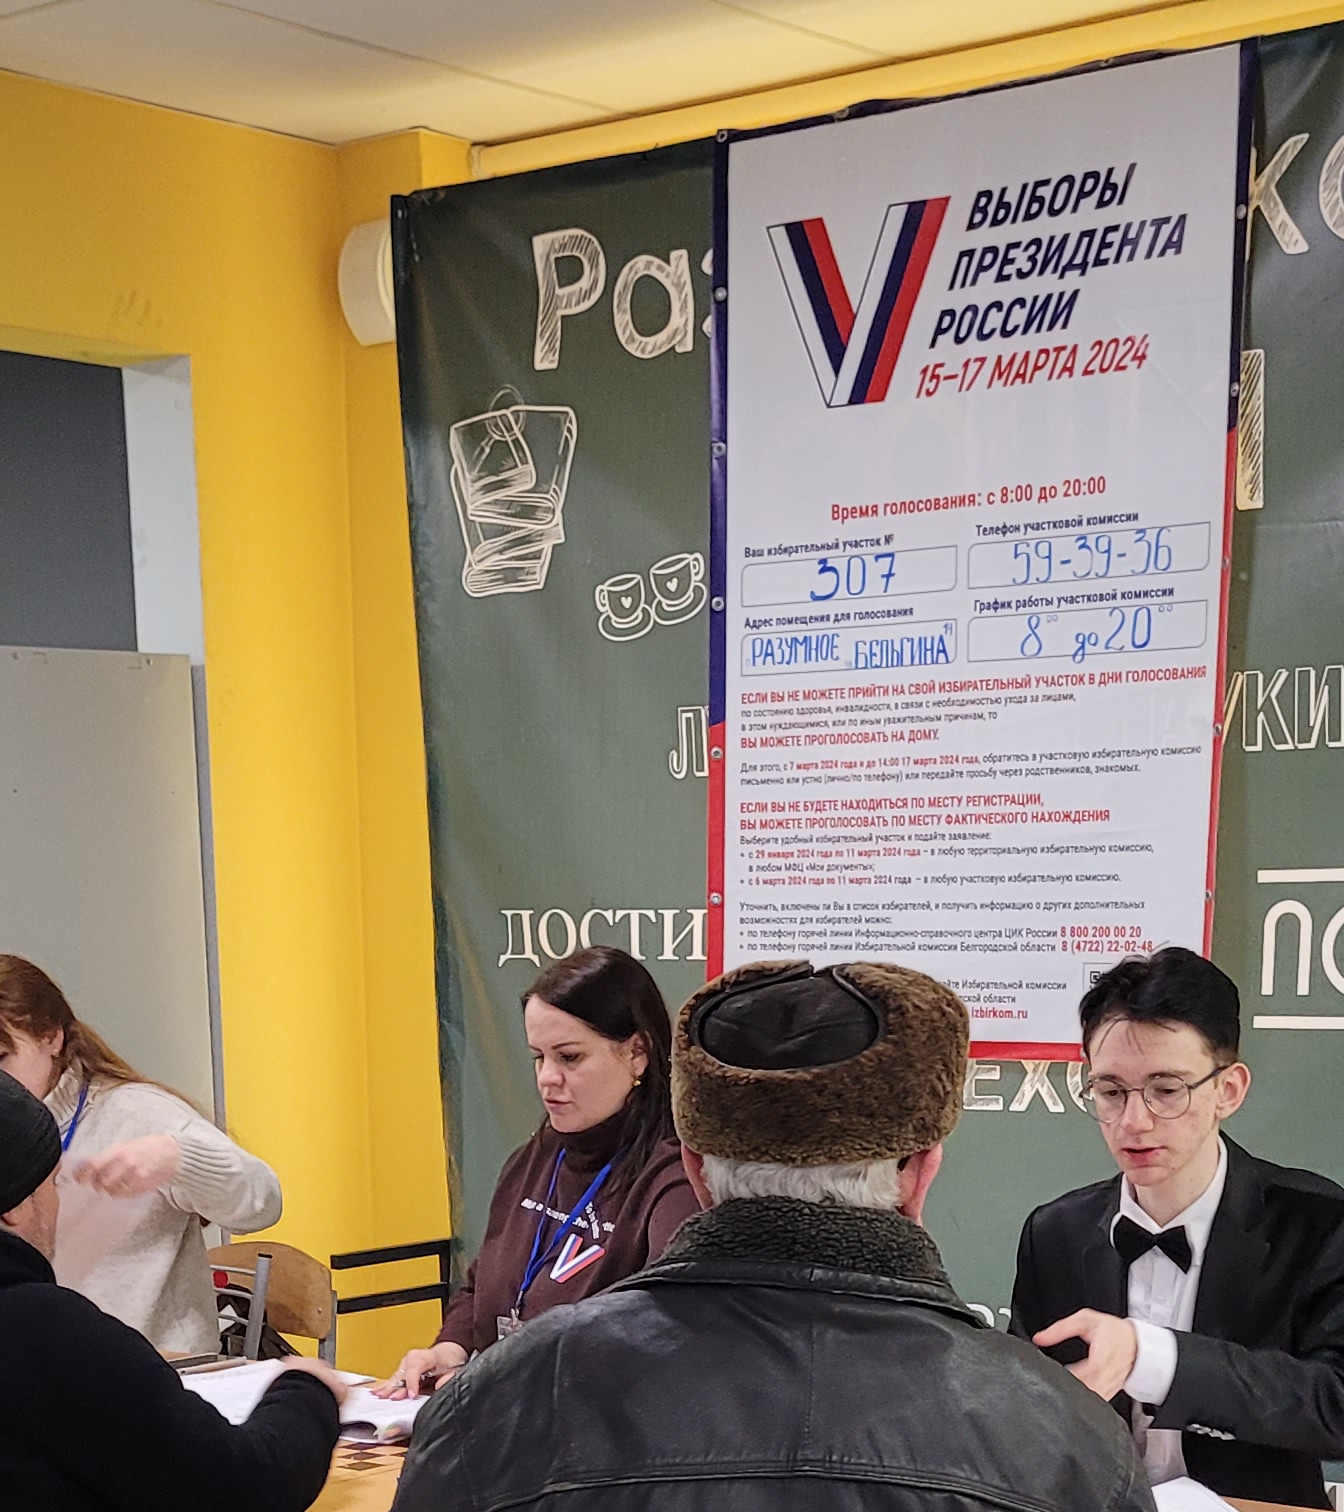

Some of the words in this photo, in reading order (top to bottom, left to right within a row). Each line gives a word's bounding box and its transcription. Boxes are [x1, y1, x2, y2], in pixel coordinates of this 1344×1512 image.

[966, 162, 1137, 232] ВЫБОРЫ
[947, 213, 1188, 291] ПРЕЗИДЕНТА
[532, 228, 713, 371] Ра
[928, 288, 1081, 349] РОССИИ
[986, 343, 1078, 389] МАРТА
[1081, 334, 1150, 377] 2024
[831, 503, 878, 522] Время
[883, 493, 981, 515] голосования:
[986, 491, 995, 505] с
[1000, 483, 1032, 503] 8:00
[1037, 485, 1057, 503] до
[1062, 475, 1105, 497] 20:00
[975, 522, 1020, 536] Телефон
[1023, 514, 1083, 535] участковой
[1086, 512, 1138, 525] комиссии
[744, 546, 764, 558] Ваш
[766, 538, 839, 556] избирательный
[841, 537, 881, 552] участок
[1012, 527, 1172, 585] 59-39-36
[810, 552, 896, 600] 307
[744, 617, 773, 629] Адрес
[775, 613, 830, 625] помещения
[832, 612, 850, 623] для
[853, 607, 913, 620] голосования
[973, 598, 1012, 613] График
[1015, 595, 1053, 611] работы
[1056, 588, 1117, 608] участковой
[1120, 587, 1174, 600] комиссии
[752, 633, 840, 666] РАЗУМНОЕ
[741, 692, 767, 704] ЕСЛИ
[770, 691, 784, 702] ВЫ
[787, 690, 800, 701] НЕ
[802, 687, 845, 700] МОЖЕТЕ
[848, 683, 889, 698] ПРИЙТИ
[891, 684, 905, 696] НА
[908, 679, 935, 695] СВОЙ
[938, 674, 1031, 692] ИЗБИРАТЕЛЬНЫЙ
[1034, 673, 1085, 687] УЧАСТОК
[1088, 672, 1095, 685] В
[1098, 671, 1122, 686] ДНИ
[1125, 665, 1206, 682] ГОЛОСОВАНИЯ
[740, 737, 757, 748] ВЫ
[759, 735, 801, 747] МОЖЕТЕ
[804, 731, 888, 745] ПРОГОЛОСОВАТЬ
[890, 730, 905, 742] НА
[739, 818, 756, 830] ВЫ
[759, 817, 802, 829] МОЖЕТЕ
[804, 815, 888, 828] ПРОГОЛОСОВАТЬ
[891, 814, 905, 826] ПО
[908, 814, 942, 825] МЕСТУ
[944, 811, 1028, 824] ФАКТИЧЕСКОГО
[1030, 809, 1110, 824] НАХОЖДЕНИЯ
[740, 801, 768, 813] ЕСЛИ
[770, 801, 785, 812] ВЫ
[788, 800, 800, 812] НЕ
[803, 799, 838, 813] БУДЕТЕ
[840, 797, 908, 811] НАХОДИТЬСЯ
[910, 796, 924, 808] ПО
[927, 795, 963, 807] МЕСТУ
[1060, 925, 1066, 937] 8
[1069, 925, 1088, 940] 800
[1091, 925, 1110, 937] 200
[1113, 925, 1126, 937] 00
[1128, 925, 1141, 937] 20
